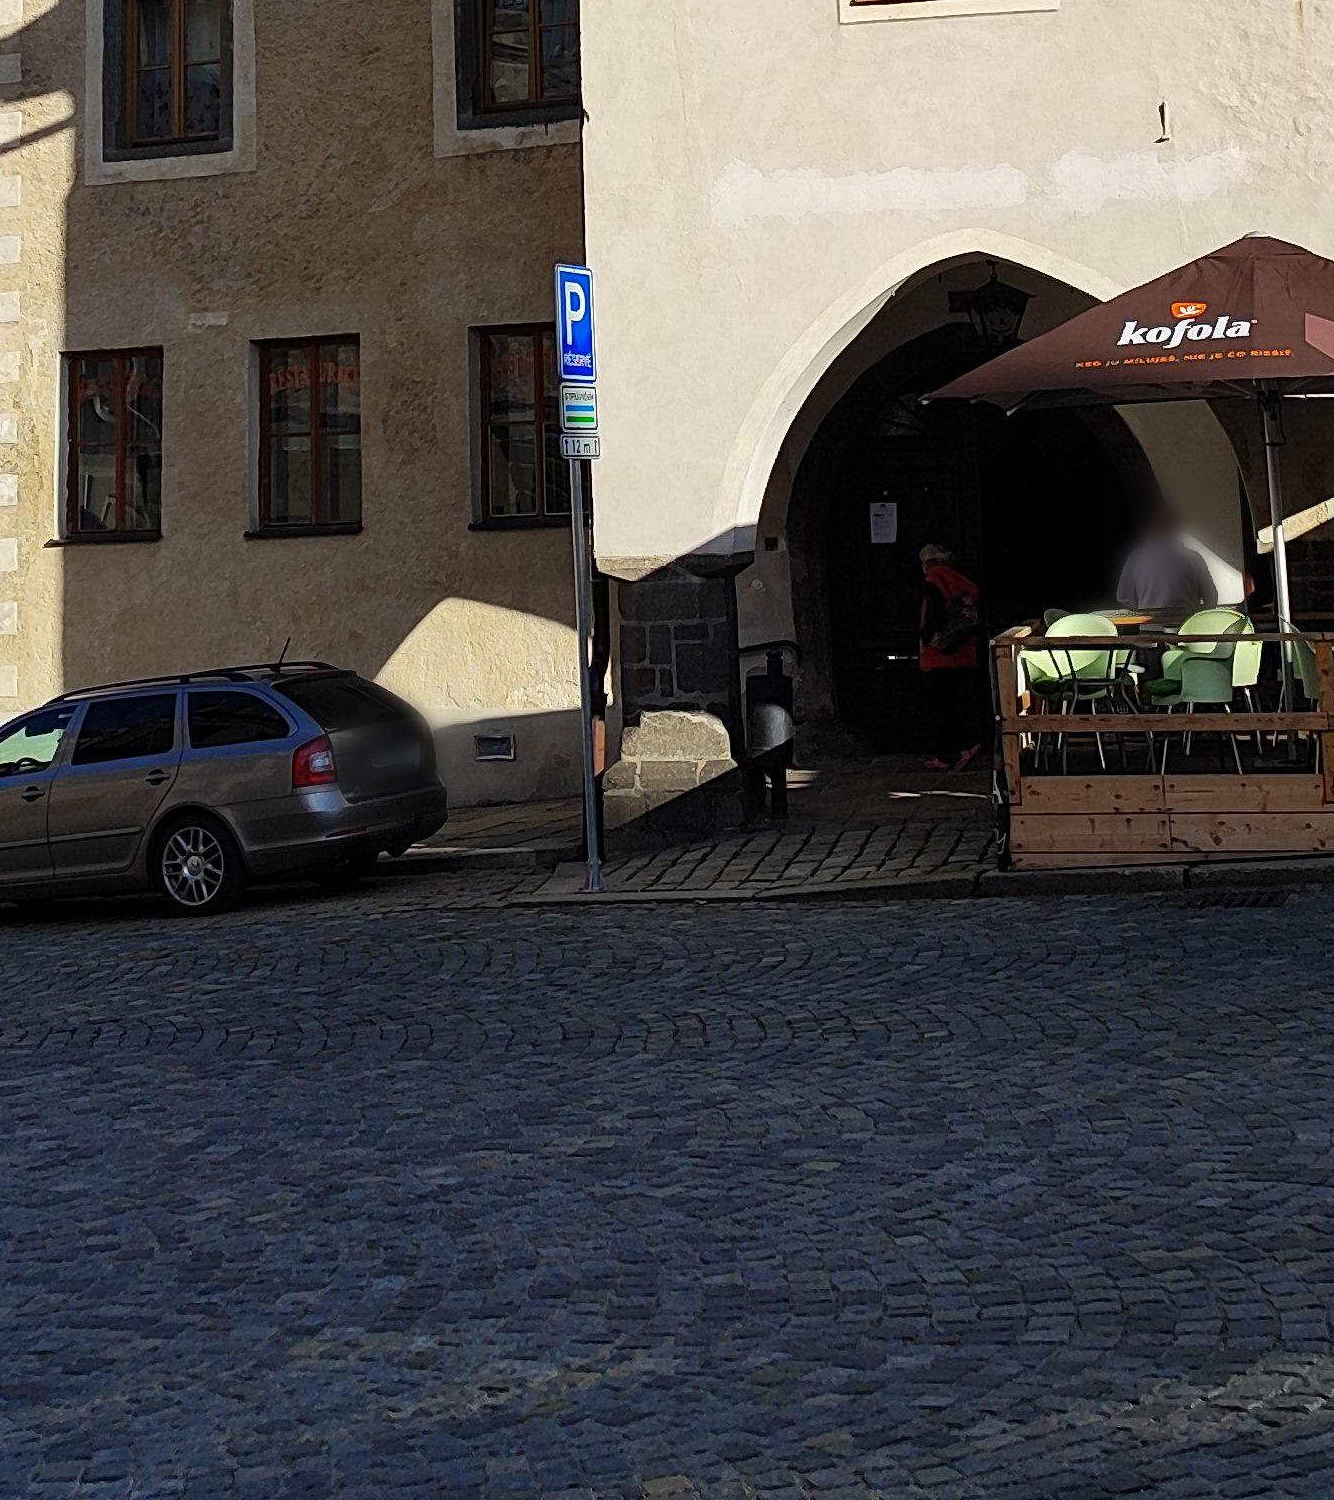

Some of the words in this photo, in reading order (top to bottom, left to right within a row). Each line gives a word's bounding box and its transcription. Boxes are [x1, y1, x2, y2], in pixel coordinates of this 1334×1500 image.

[564, 281, 585, 346] P
[1116, 315, 1251, 349] kofola
[572, 439, 581, 454] 12
